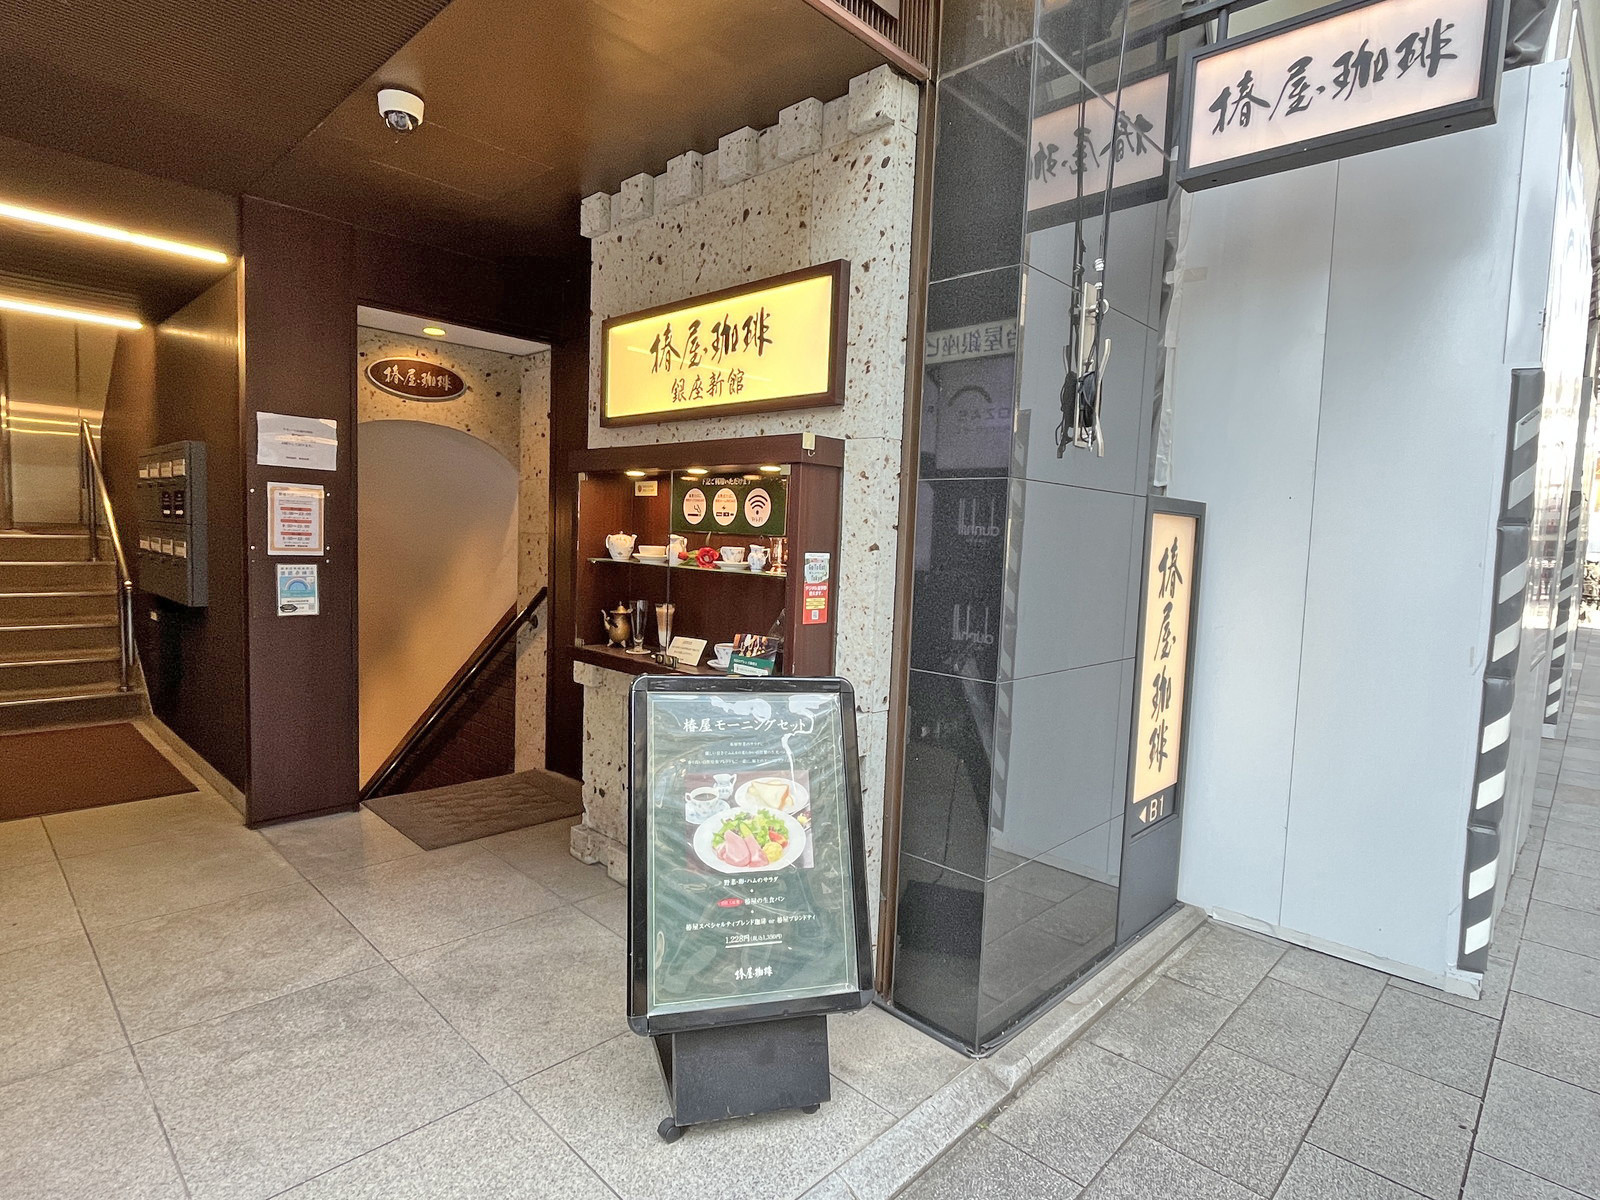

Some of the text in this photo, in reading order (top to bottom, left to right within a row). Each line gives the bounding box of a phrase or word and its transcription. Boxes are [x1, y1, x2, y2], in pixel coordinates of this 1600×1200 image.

[1208, 18, 1458, 136] 椿屋珈琲
[650, 306, 774, 374] 椿屋珈琲
[383, 364, 453, 391] 椿屋珈琲
[671, 367, 745, 403] 銀座新館
[1147, 536, 1183, 773] 椿屋珈琲
[683, 717, 806, 732] 椿屋モーニングセット
[1150, 794, 1165, 822] B1
